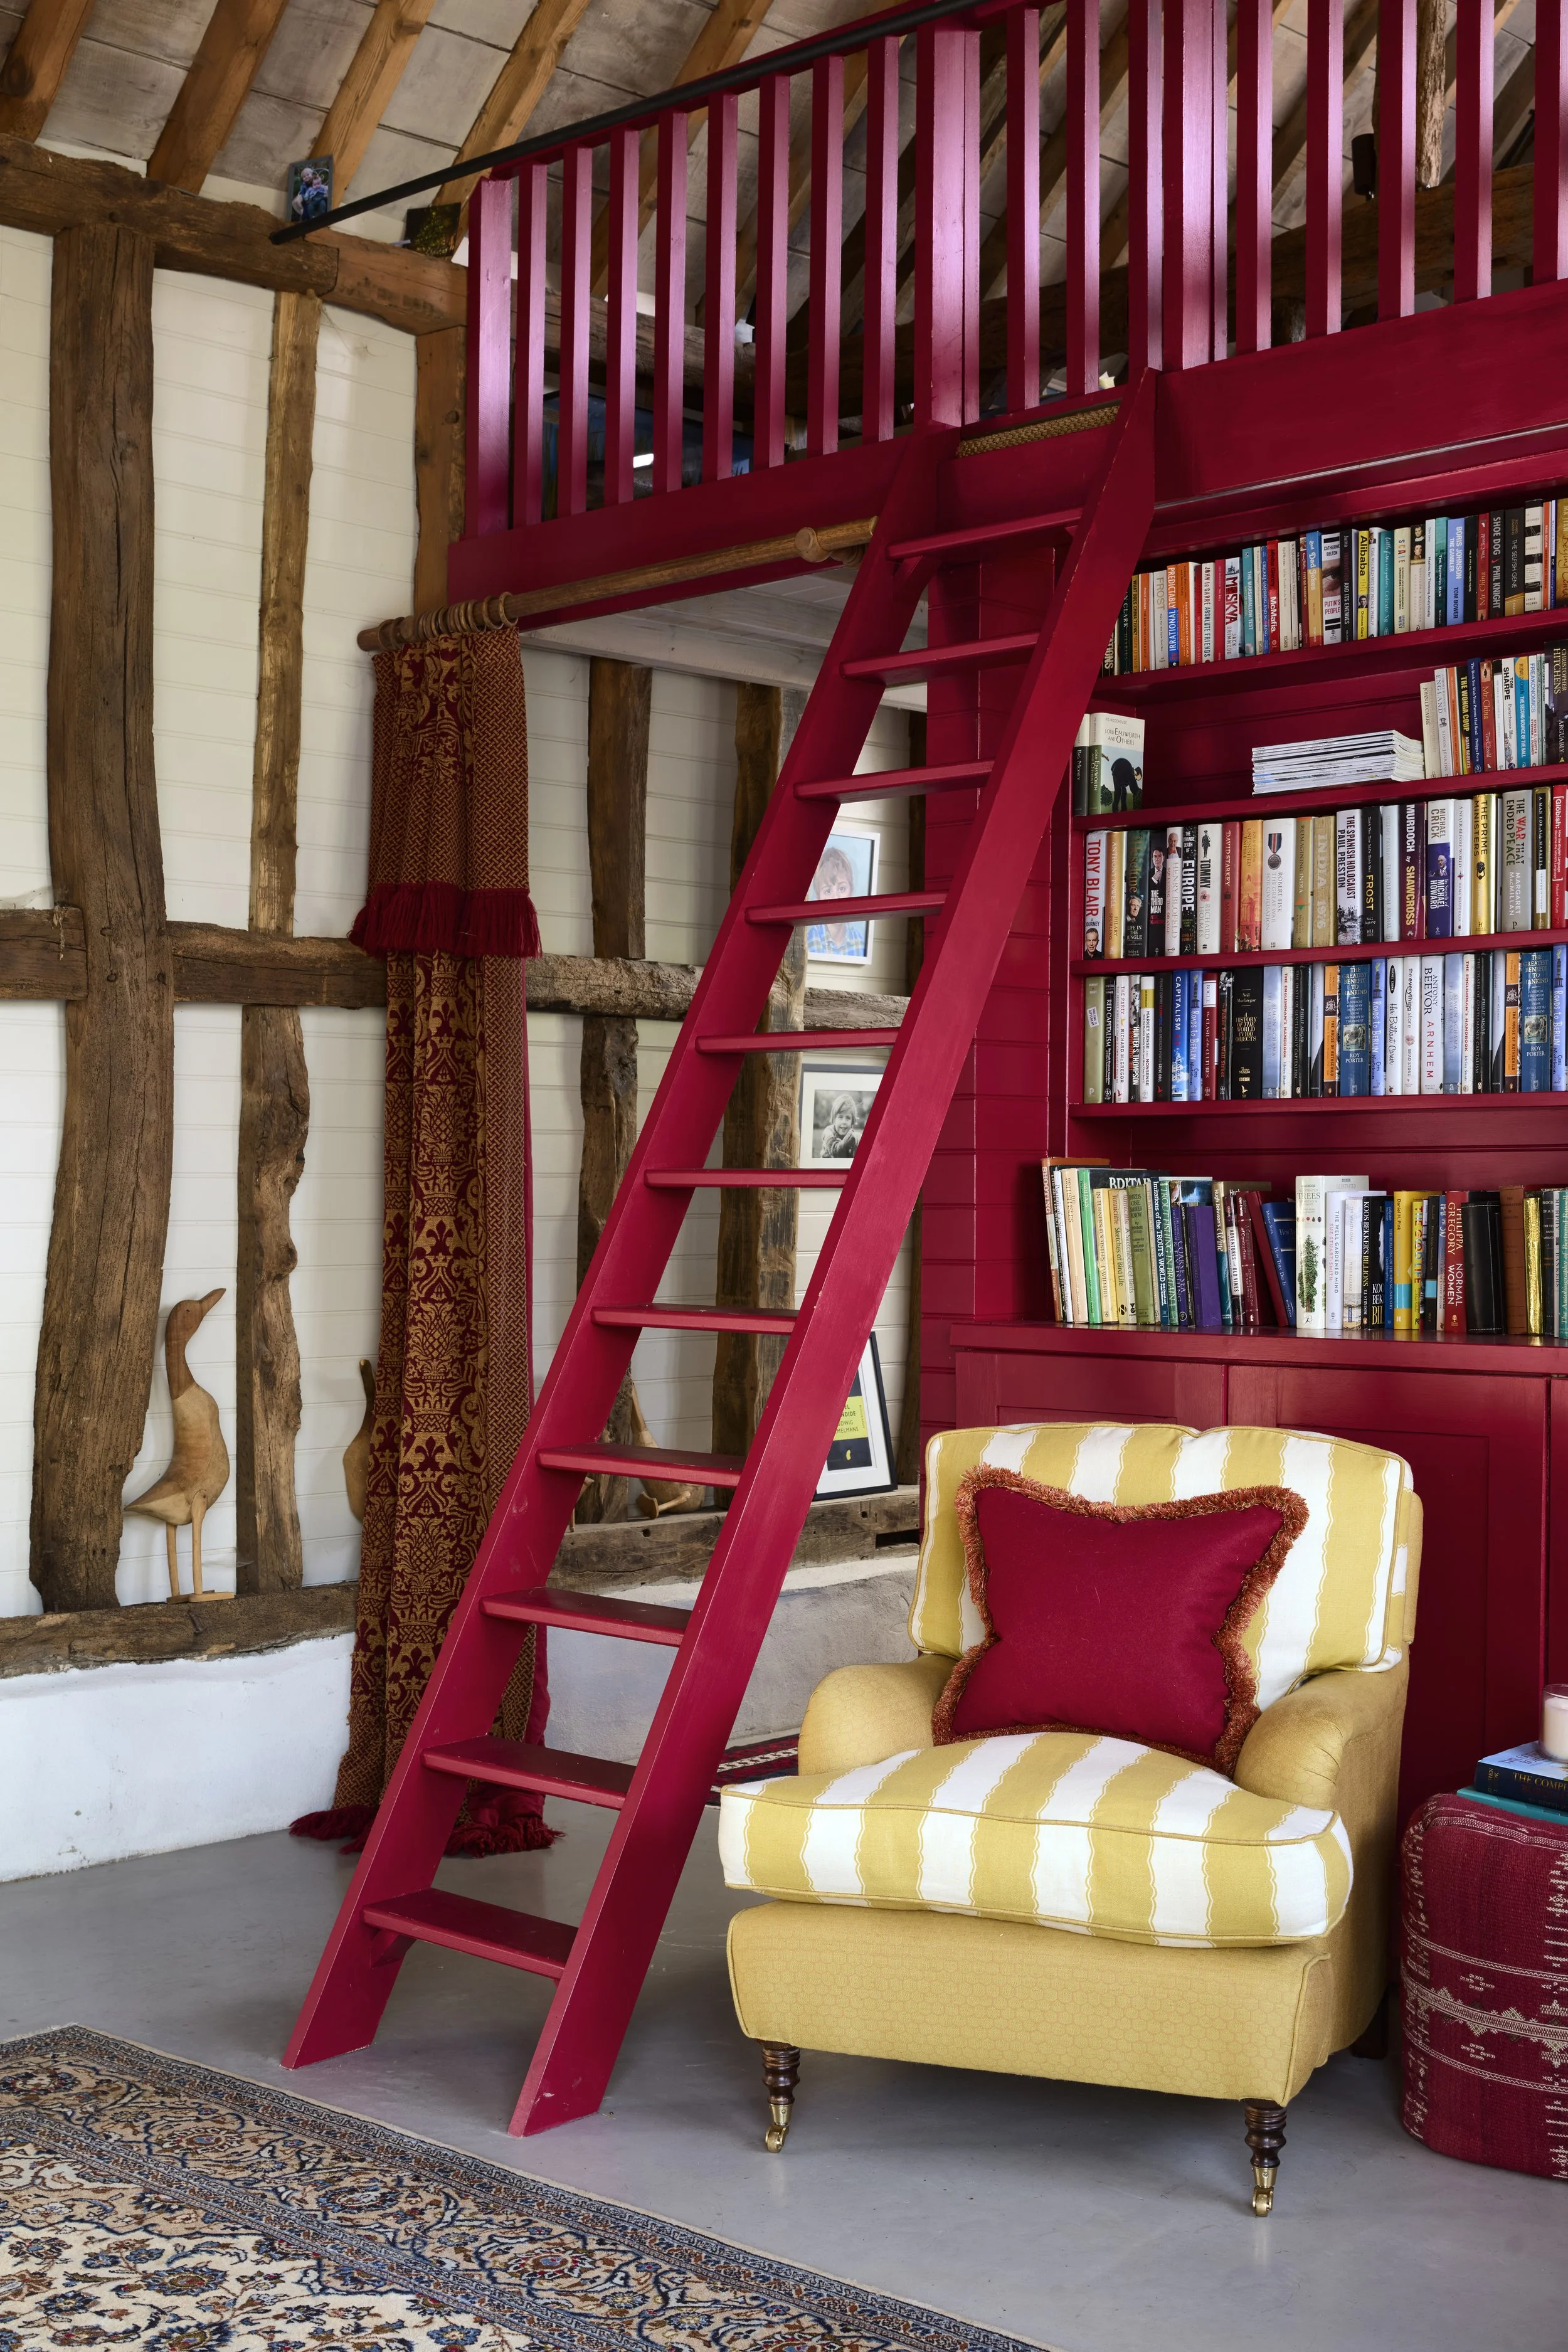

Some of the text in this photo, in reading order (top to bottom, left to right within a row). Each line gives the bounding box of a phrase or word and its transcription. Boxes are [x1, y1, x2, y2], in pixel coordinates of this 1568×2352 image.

[1359, 535, 1368, 576] Alibaba
[1156, 577, 1165, 610] FROST
[1493, 566, 1501, 609] PHIL KNIGHT
[1325, 607, 1340, 615] PEOPLE
[1406, 804, 1415, 852] MURDOCH
[1431, 808, 1439, 839] CRICK
[1506, 799, 1515, 866] ENDED PEACE
[1200, 859, 1211, 889] TOMMY
[1337, 829, 1345, 889] PAUL PRESTON
[1347, 815, 1355, 899] THE SPANISH HOLOCAUST
[1086, 839, 1101, 917] TONY BLAIR
[1182, 860, 1195, 912] EUROPE
[1406, 866, 1415, 926] SHAWCROSS
[1150, 905, 1162, 914] MAN
[1151, 898, 1163, 906] THIRD
[1424, 967, 1433, 1015] BEEVOR
[1426, 1020, 1434, 1078] ARNHEM
[1042, 1166, 1052, 1215] SHOOTING
[1156, 1230, 1164, 1257] TROUT'S
[1162, 1219, 1171, 1253] FISHING
[1216, 1228, 1225, 1252] Wine
[1448, 1202, 1456, 1255] GREGORY
[1166, 1254, 1172, 1264] IN
[1167, 1268, 1175, 1301] BRITAIN
[1512, 1771, 1532, 1783] THE
